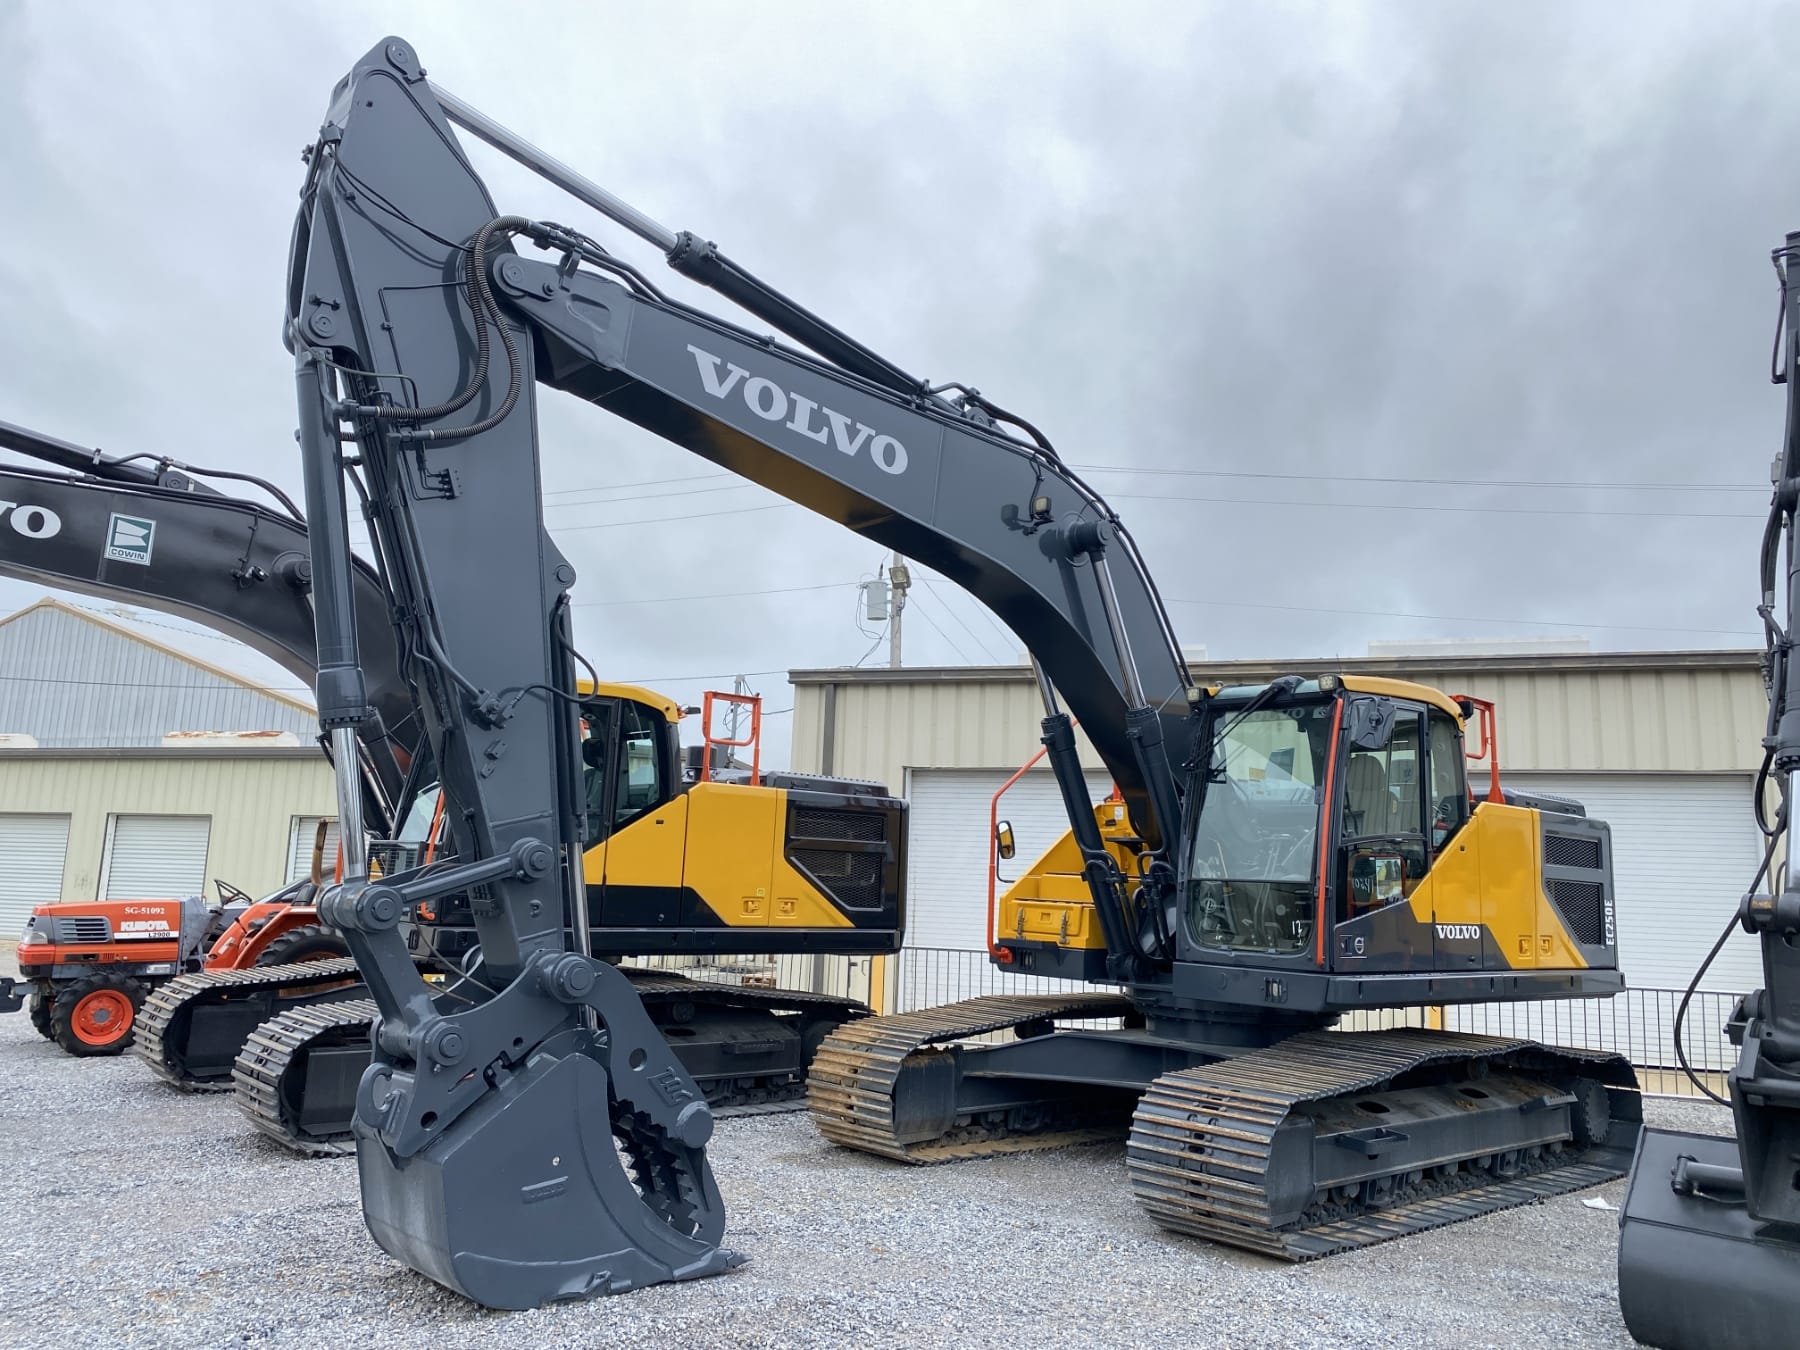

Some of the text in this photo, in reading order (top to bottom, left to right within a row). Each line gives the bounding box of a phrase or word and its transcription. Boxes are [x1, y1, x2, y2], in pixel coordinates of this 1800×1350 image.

[687, 344, 908, 475] VOLVO
[110, 548, 145, 560] COWIN
[124, 906, 165, 915] SG-51092
[1604, 899, 1615, 946] EC250E
[1435, 925, 1480, 940] VOLVO
